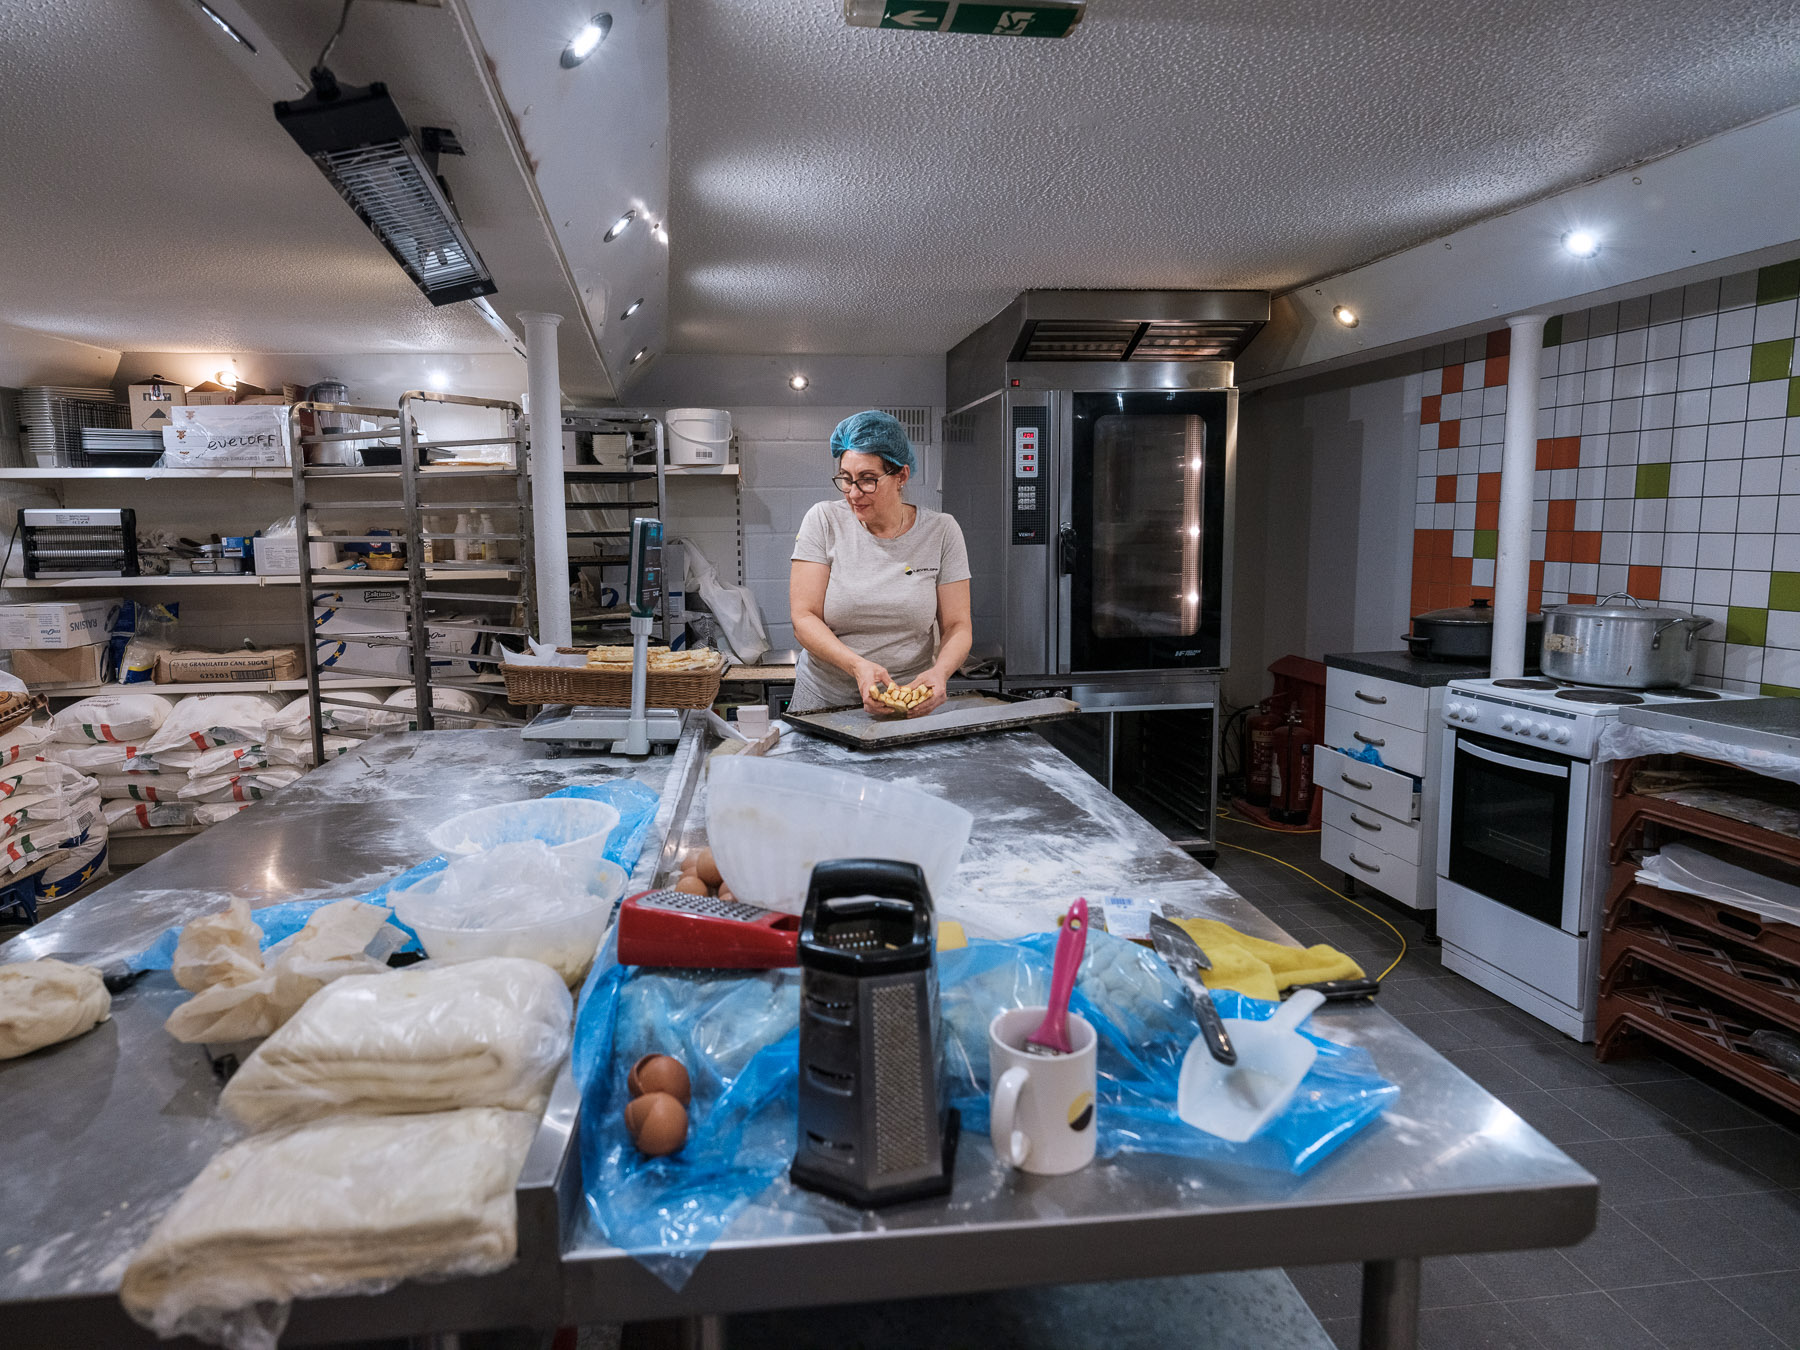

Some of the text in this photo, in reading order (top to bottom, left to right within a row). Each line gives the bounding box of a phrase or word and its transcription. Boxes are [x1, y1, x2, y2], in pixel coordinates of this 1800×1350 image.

[69, 618, 98, 633] RAISINS
[189, 660, 229, 668] GRANULATED
[247, 659, 269, 667] SUGAR
